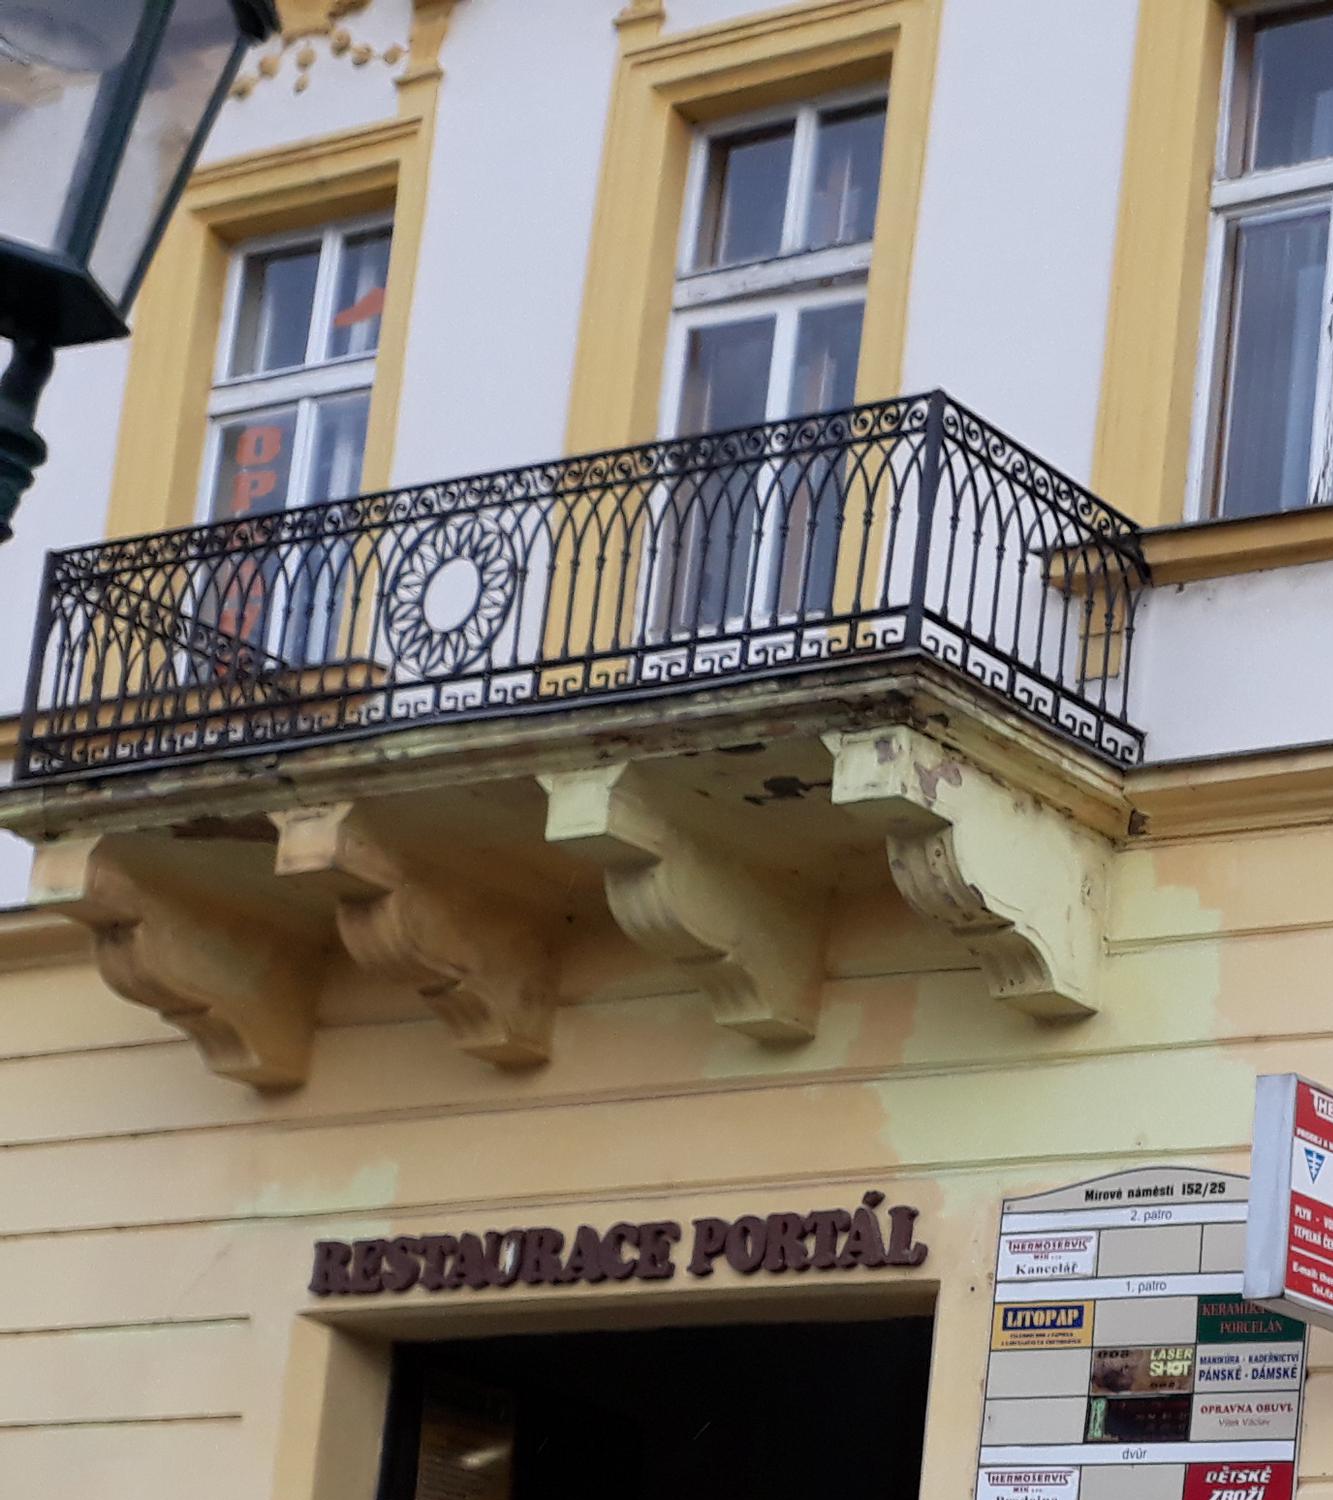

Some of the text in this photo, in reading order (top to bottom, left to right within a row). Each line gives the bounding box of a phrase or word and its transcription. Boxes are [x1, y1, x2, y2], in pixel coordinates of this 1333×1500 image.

[1130, 1209, 1172, 1223] 2. patro
[308, 1190, 929, 1296] RESTAURACE PORTÁL
[1016, 1261, 1078, 1275] Kancelář
[1126, 1279, 1167, 1293] 1. patro
[1006, 1308, 1080, 1328] LITOPAP
[1151, 1348, 1193, 1360] LASER
[1150, 1360, 1192, 1376] SHOT
[1199, 1364, 1298, 1381] PÁNSKÉ DÁMSKÉ
[1201, 1404, 1252, 1414] OPRAVNA
[1122, 1447, 1147, 1460] dvůr
[1204, 1465, 1272, 1484] DĚTSKÉ
